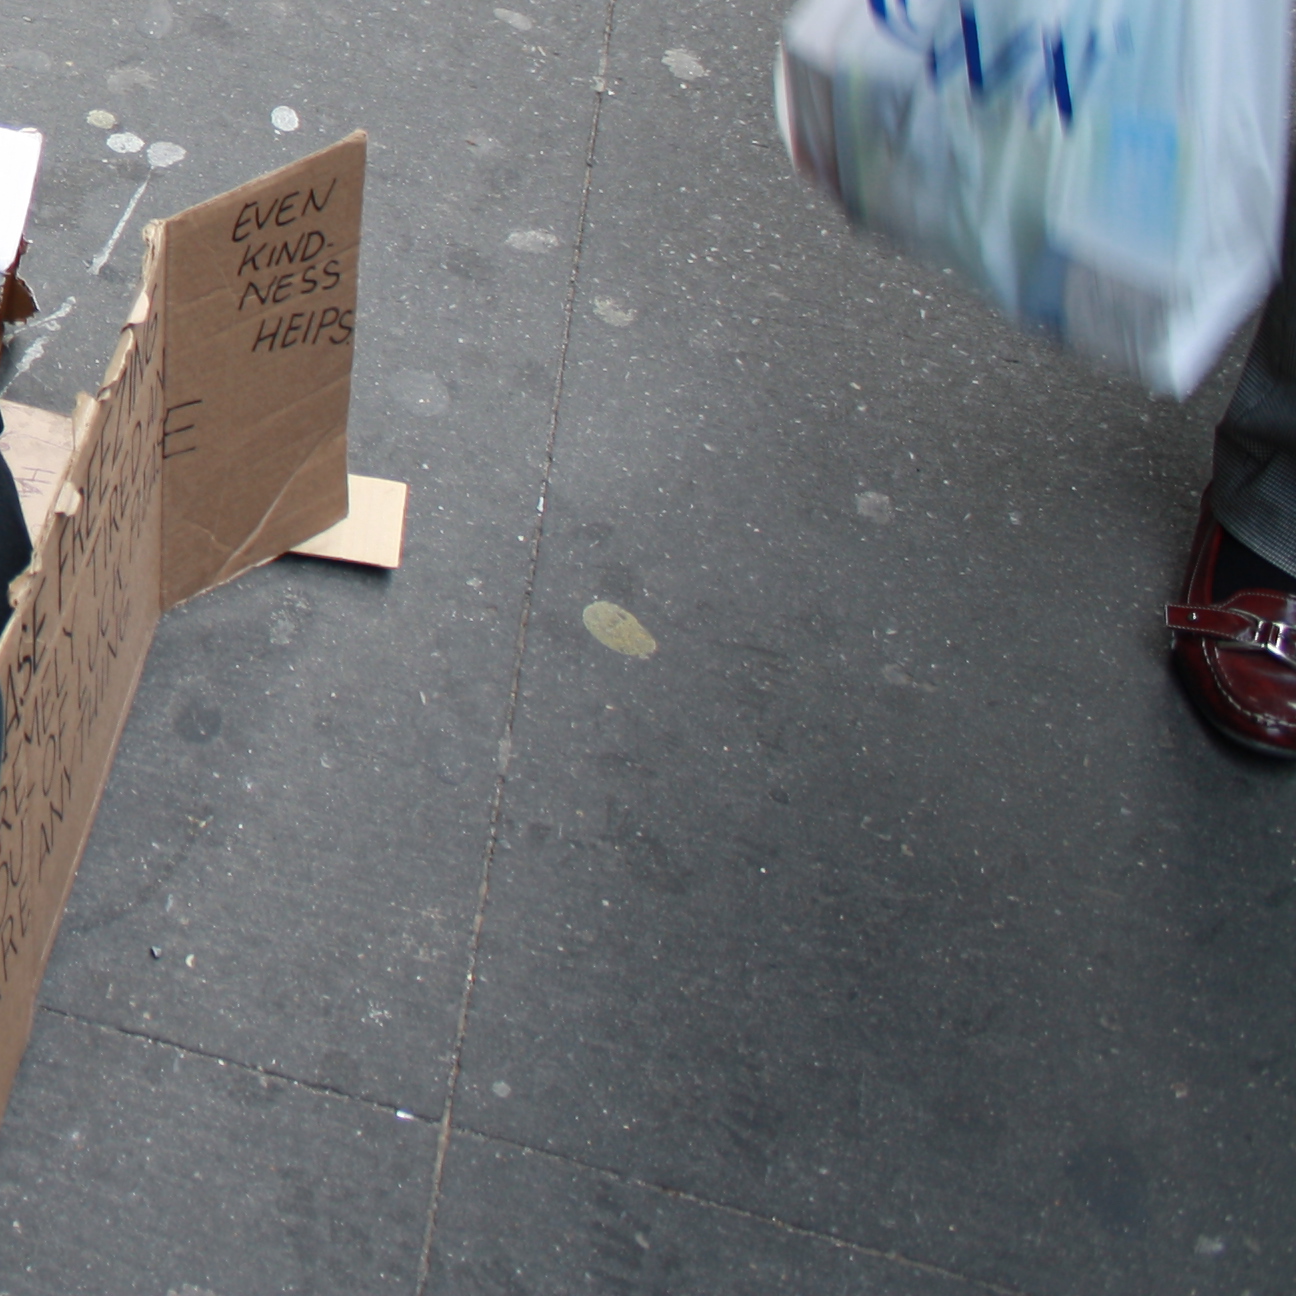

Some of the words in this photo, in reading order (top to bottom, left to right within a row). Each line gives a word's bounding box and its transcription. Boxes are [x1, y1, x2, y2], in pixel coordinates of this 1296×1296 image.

[232, 178, 336, 242] EVEN
[237, 230, 334, 276] KIND-
[239, 260, 340, 310] NESS
[58, 281, 158, 615] FREEZING
[86, 421, 142, 597] TIRED
[42, 690, 68, 797] OF
